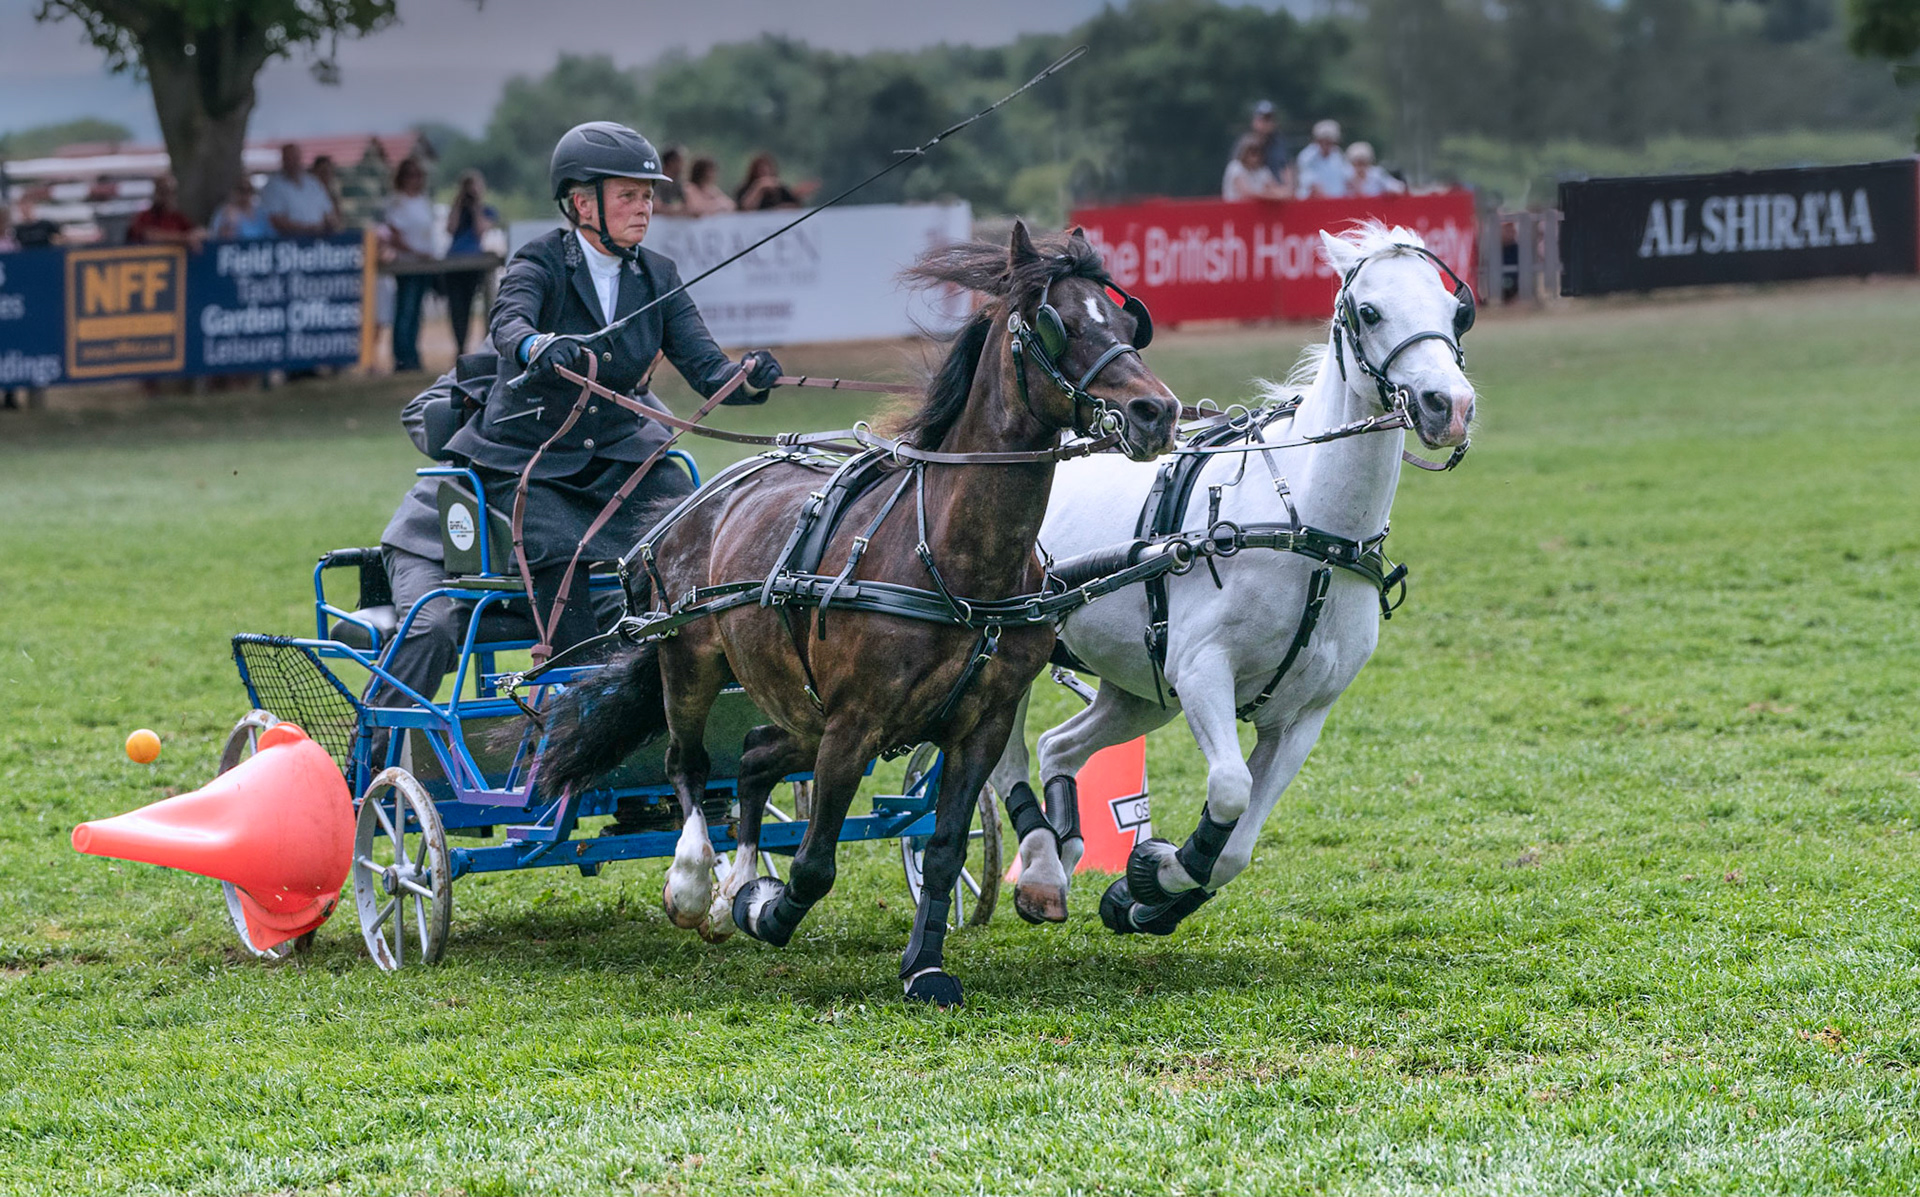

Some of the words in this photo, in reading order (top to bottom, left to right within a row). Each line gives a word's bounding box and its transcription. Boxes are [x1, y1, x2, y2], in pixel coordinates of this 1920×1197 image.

[1638, 199, 1699, 258] AL
[216, 241, 273, 277] Field
[274, 238, 363, 274] Shelters
[1144, 219, 1247, 287] British
[1252, 222, 1335, 280] Hors
[84, 260, 170, 313] NFF
[200, 301, 285, 337] Garden
[286, 297, 362, 331] Offices
[203, 335, 284, 365] Leisure
[287, 331, 361, 360] Rooms
